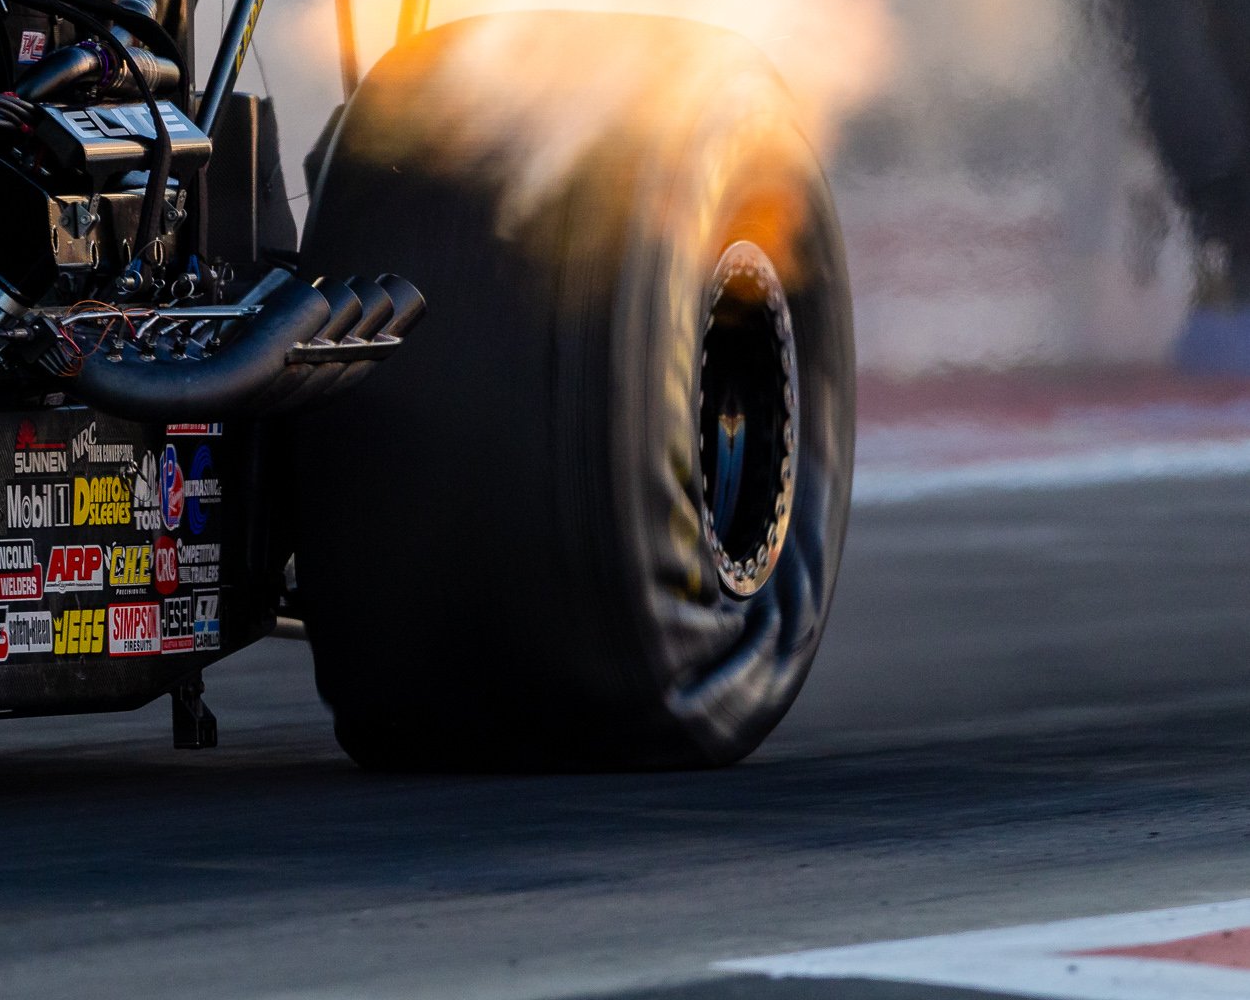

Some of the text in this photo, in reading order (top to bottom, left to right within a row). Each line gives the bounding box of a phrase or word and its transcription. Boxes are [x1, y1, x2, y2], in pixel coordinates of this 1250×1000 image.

[62, 104, 189, 139] ELITE
[72, 421, 97, 463] NRC
[14, 451, 67, 474] SUNNEN
[7, 484, 67, 528] Mobil 1
[73, 476, 130, 526] DARTON
[89, 502, 131, 525] SLEEVES
[46, 547, 103, 582] ARP
[177, 538, 221, 564] COMPETITION
[0, 576, 38, 596] WELDERS
[9, 615, 51, 651] safety-kleen
[54, 609, 106, 655] JEGS
[113, 605, 157, 640] SIMPSON
[162, 597, 195, 637] JESEL
[124, 640, 152, 652] FIRESUITS
